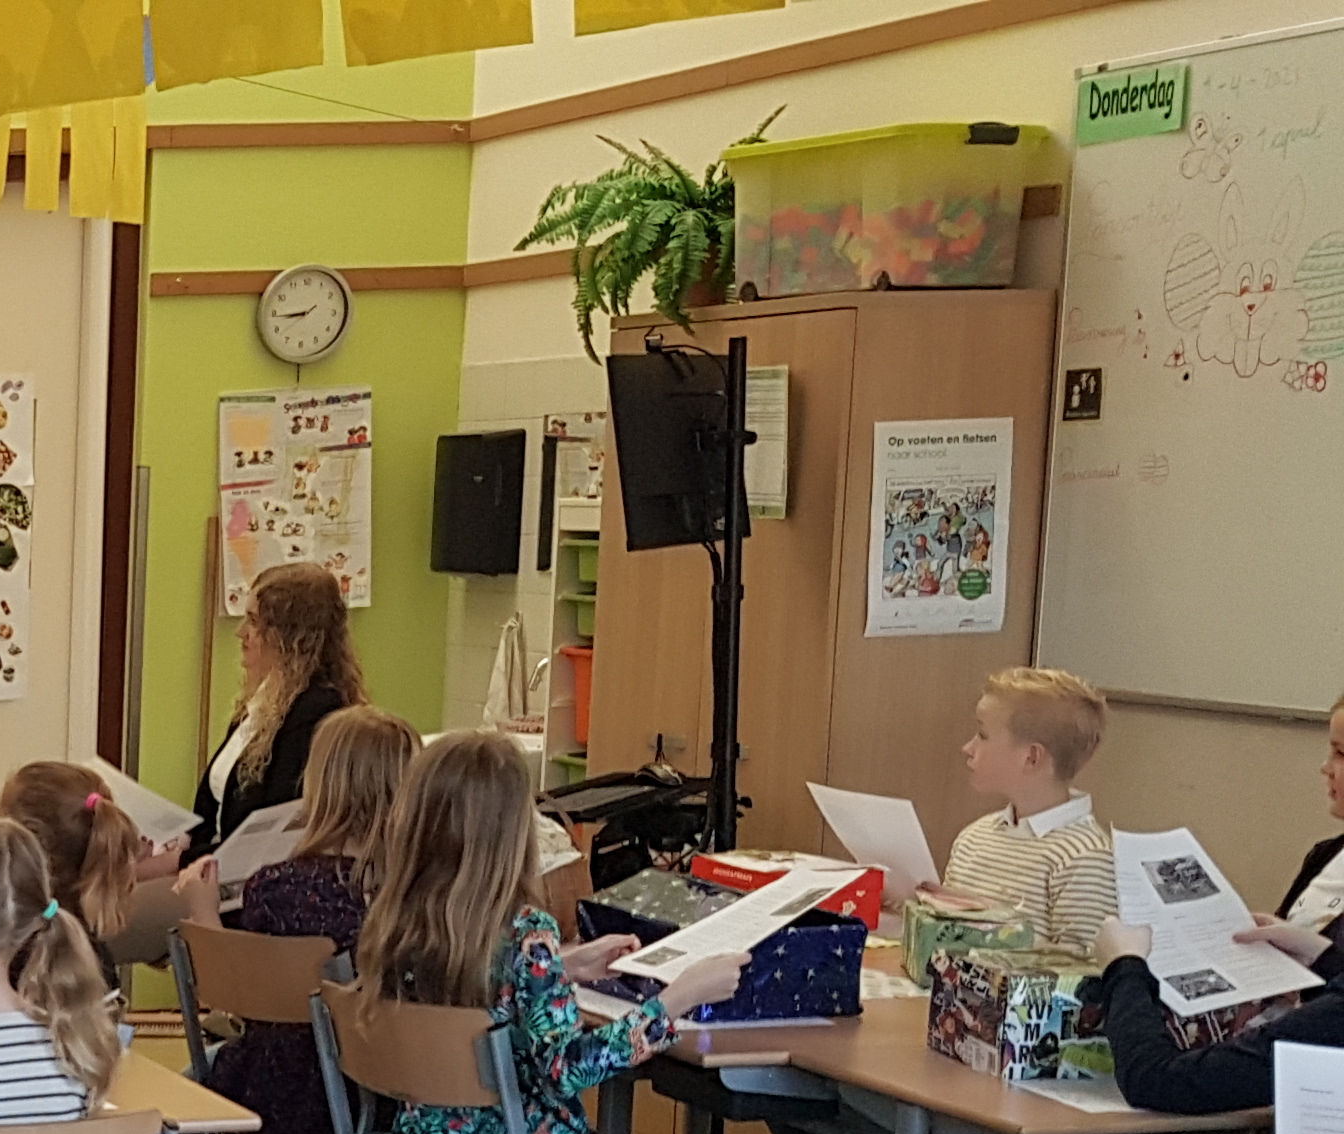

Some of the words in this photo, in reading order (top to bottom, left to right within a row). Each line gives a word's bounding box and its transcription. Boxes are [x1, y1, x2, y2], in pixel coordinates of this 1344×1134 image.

[1088, 68, 1175, 120] Donderdag
[888, 436, 904, 447] Op
[908, 435, 944, 445] voeten
[947, 435, 960, 444] en
[962, 433, 997, 444] fietsen
[913, 448, 947, 460] school
